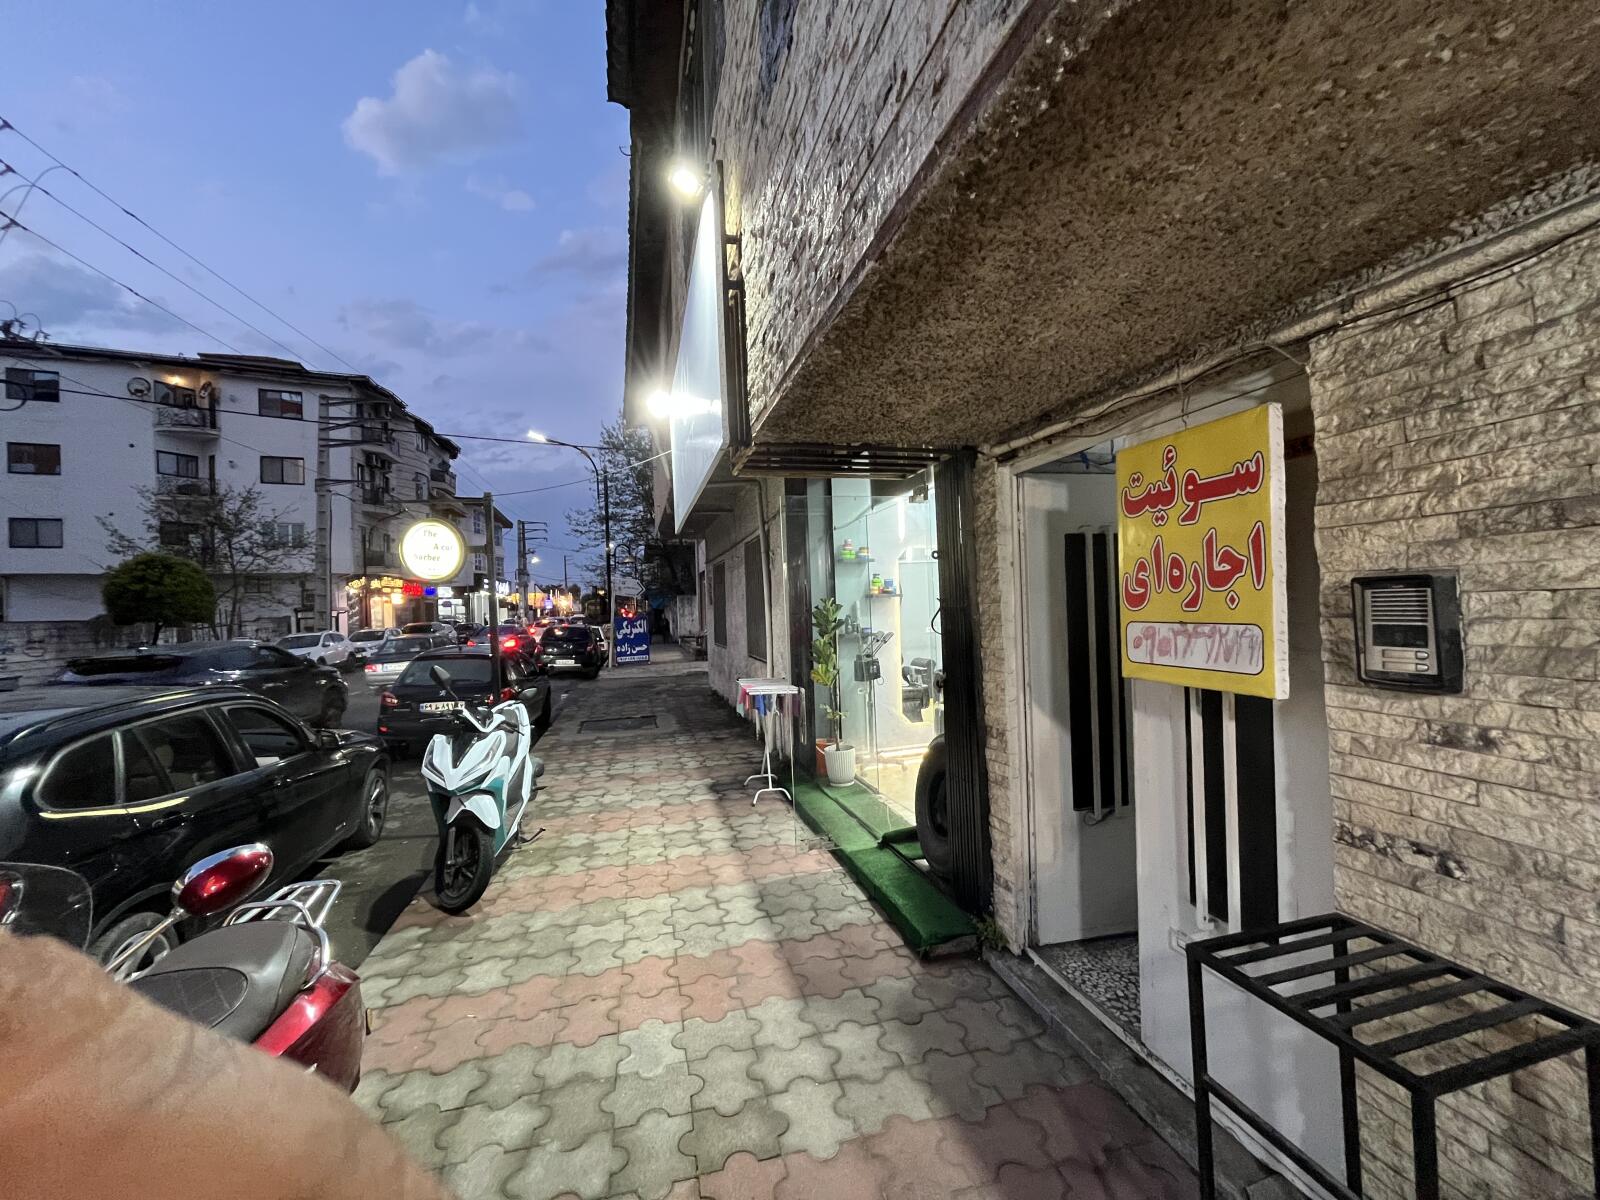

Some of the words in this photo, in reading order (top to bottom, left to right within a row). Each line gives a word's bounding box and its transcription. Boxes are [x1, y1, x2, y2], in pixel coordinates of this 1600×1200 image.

[1122, 445, 1264, 526] سوئیت
[616, 643, 631, 654] زاده
[631, 643, 648, 654] حسن
